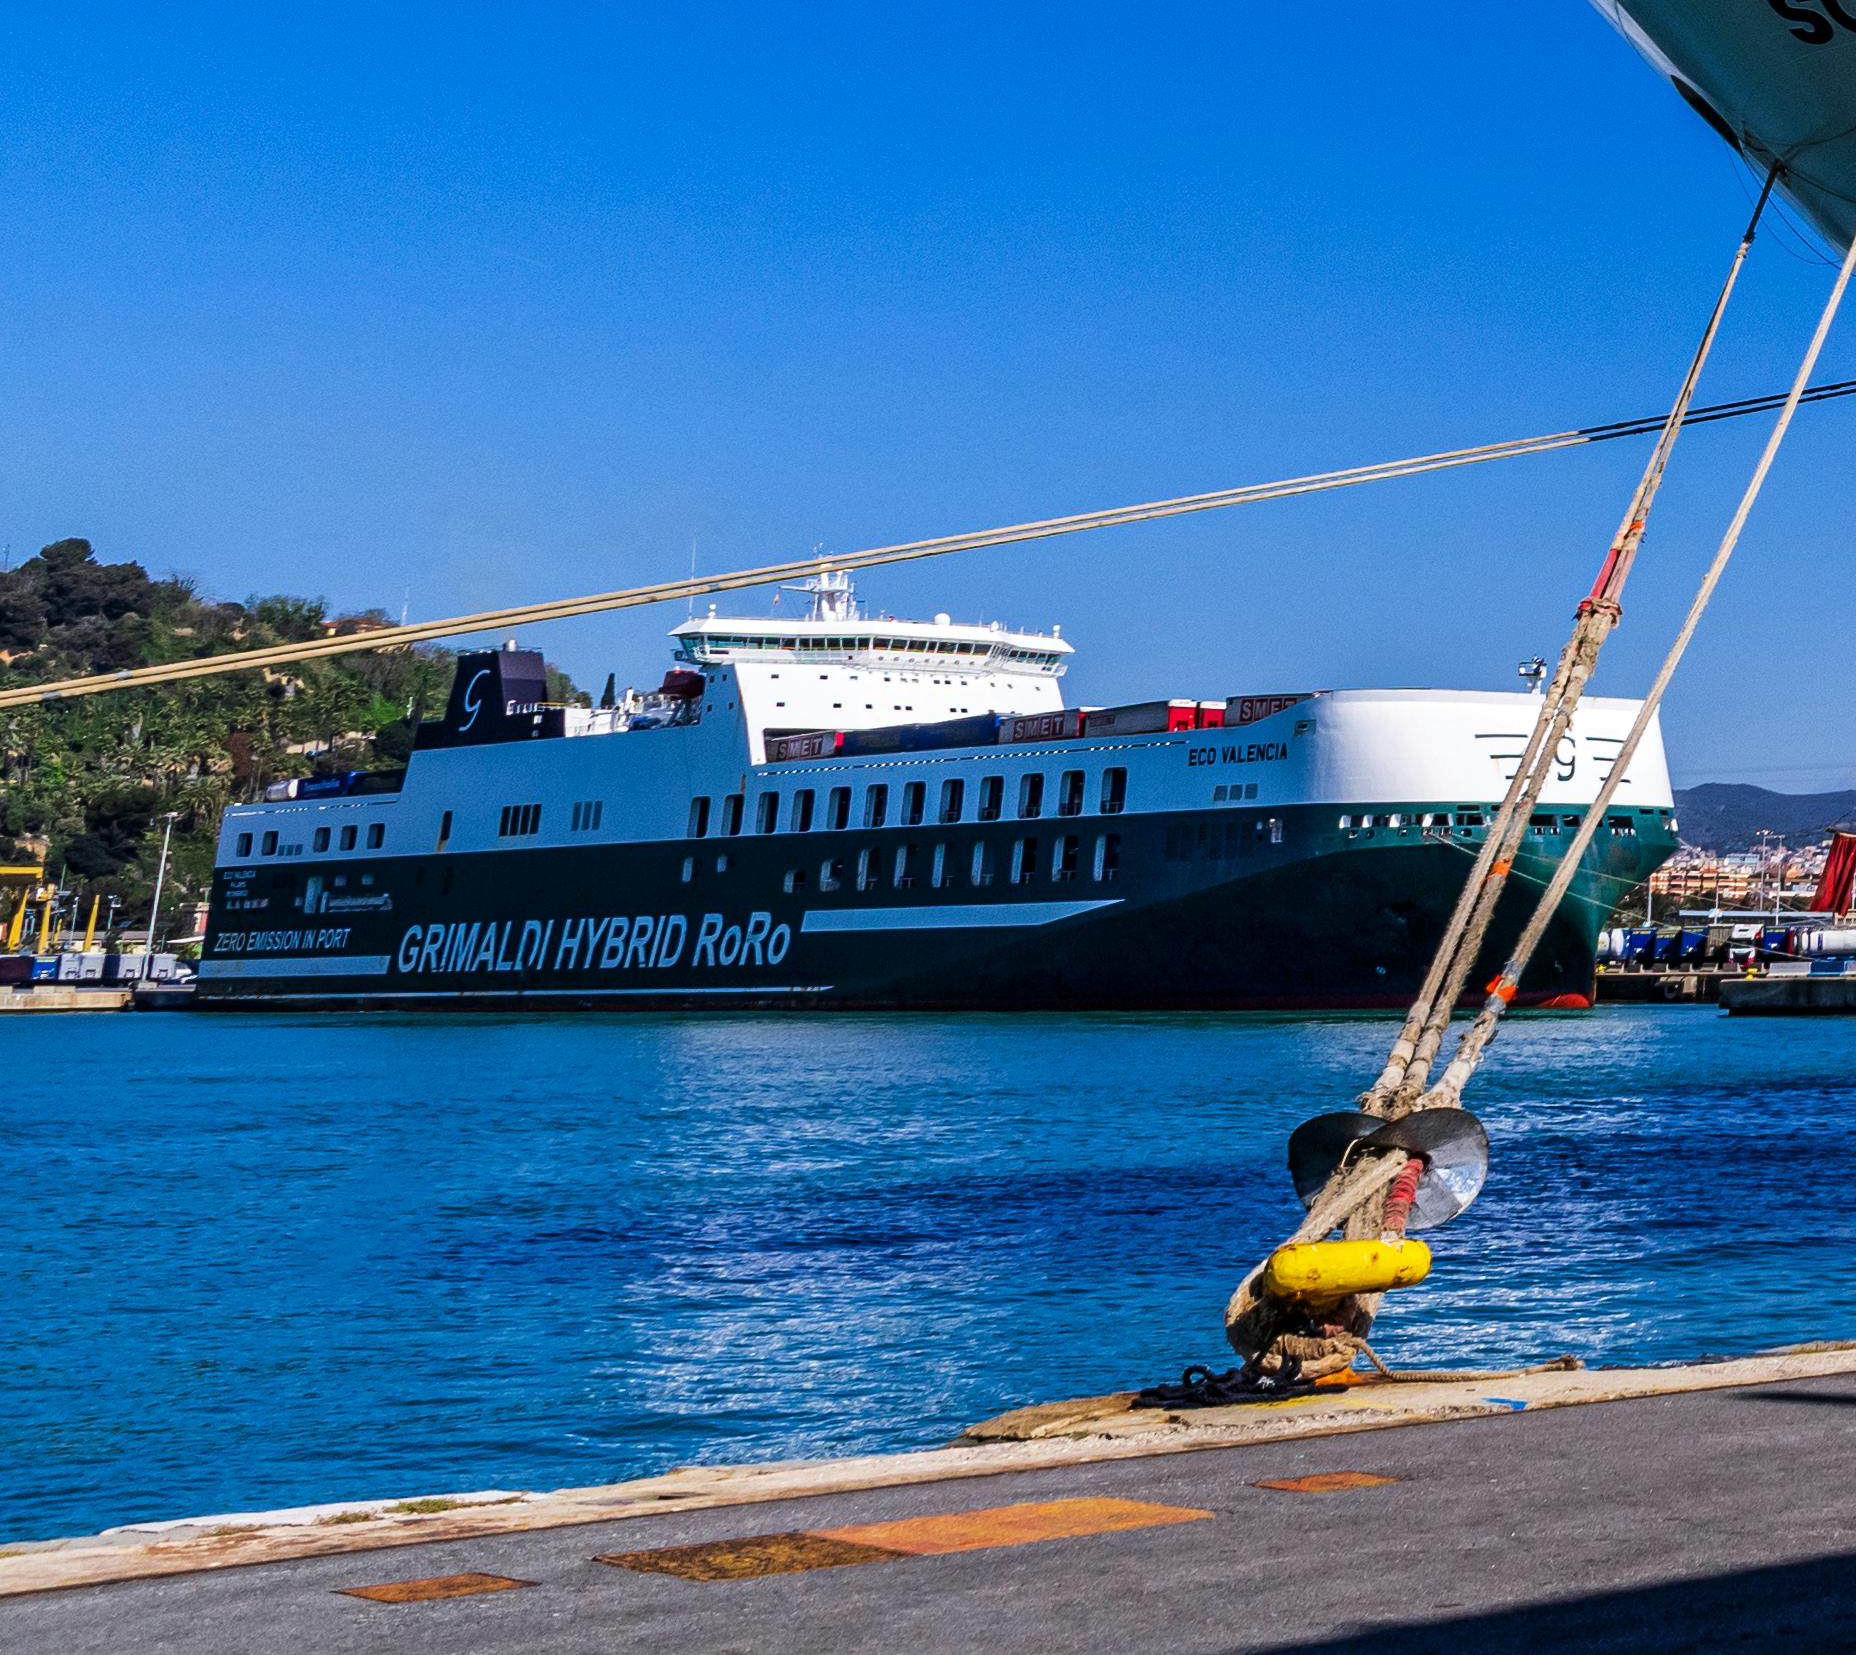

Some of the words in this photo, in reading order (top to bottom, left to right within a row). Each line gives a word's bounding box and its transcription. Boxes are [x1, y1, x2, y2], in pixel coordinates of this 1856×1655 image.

[1188, 747, 1216, 767] ECO
[1221, 742, 1288, 764] VALENCIA
[213, 932, 247, 952] ZERO
[246, 929, 303, 951] EMISSION
[301, 929, 317, 949] IN
[316, 927, 352, 949] PORT
[398, 919, 555, 973] GRIMALDI
[553, 914, 687, 970] HYBRID
[692, 911, 791, 967] RoRo
